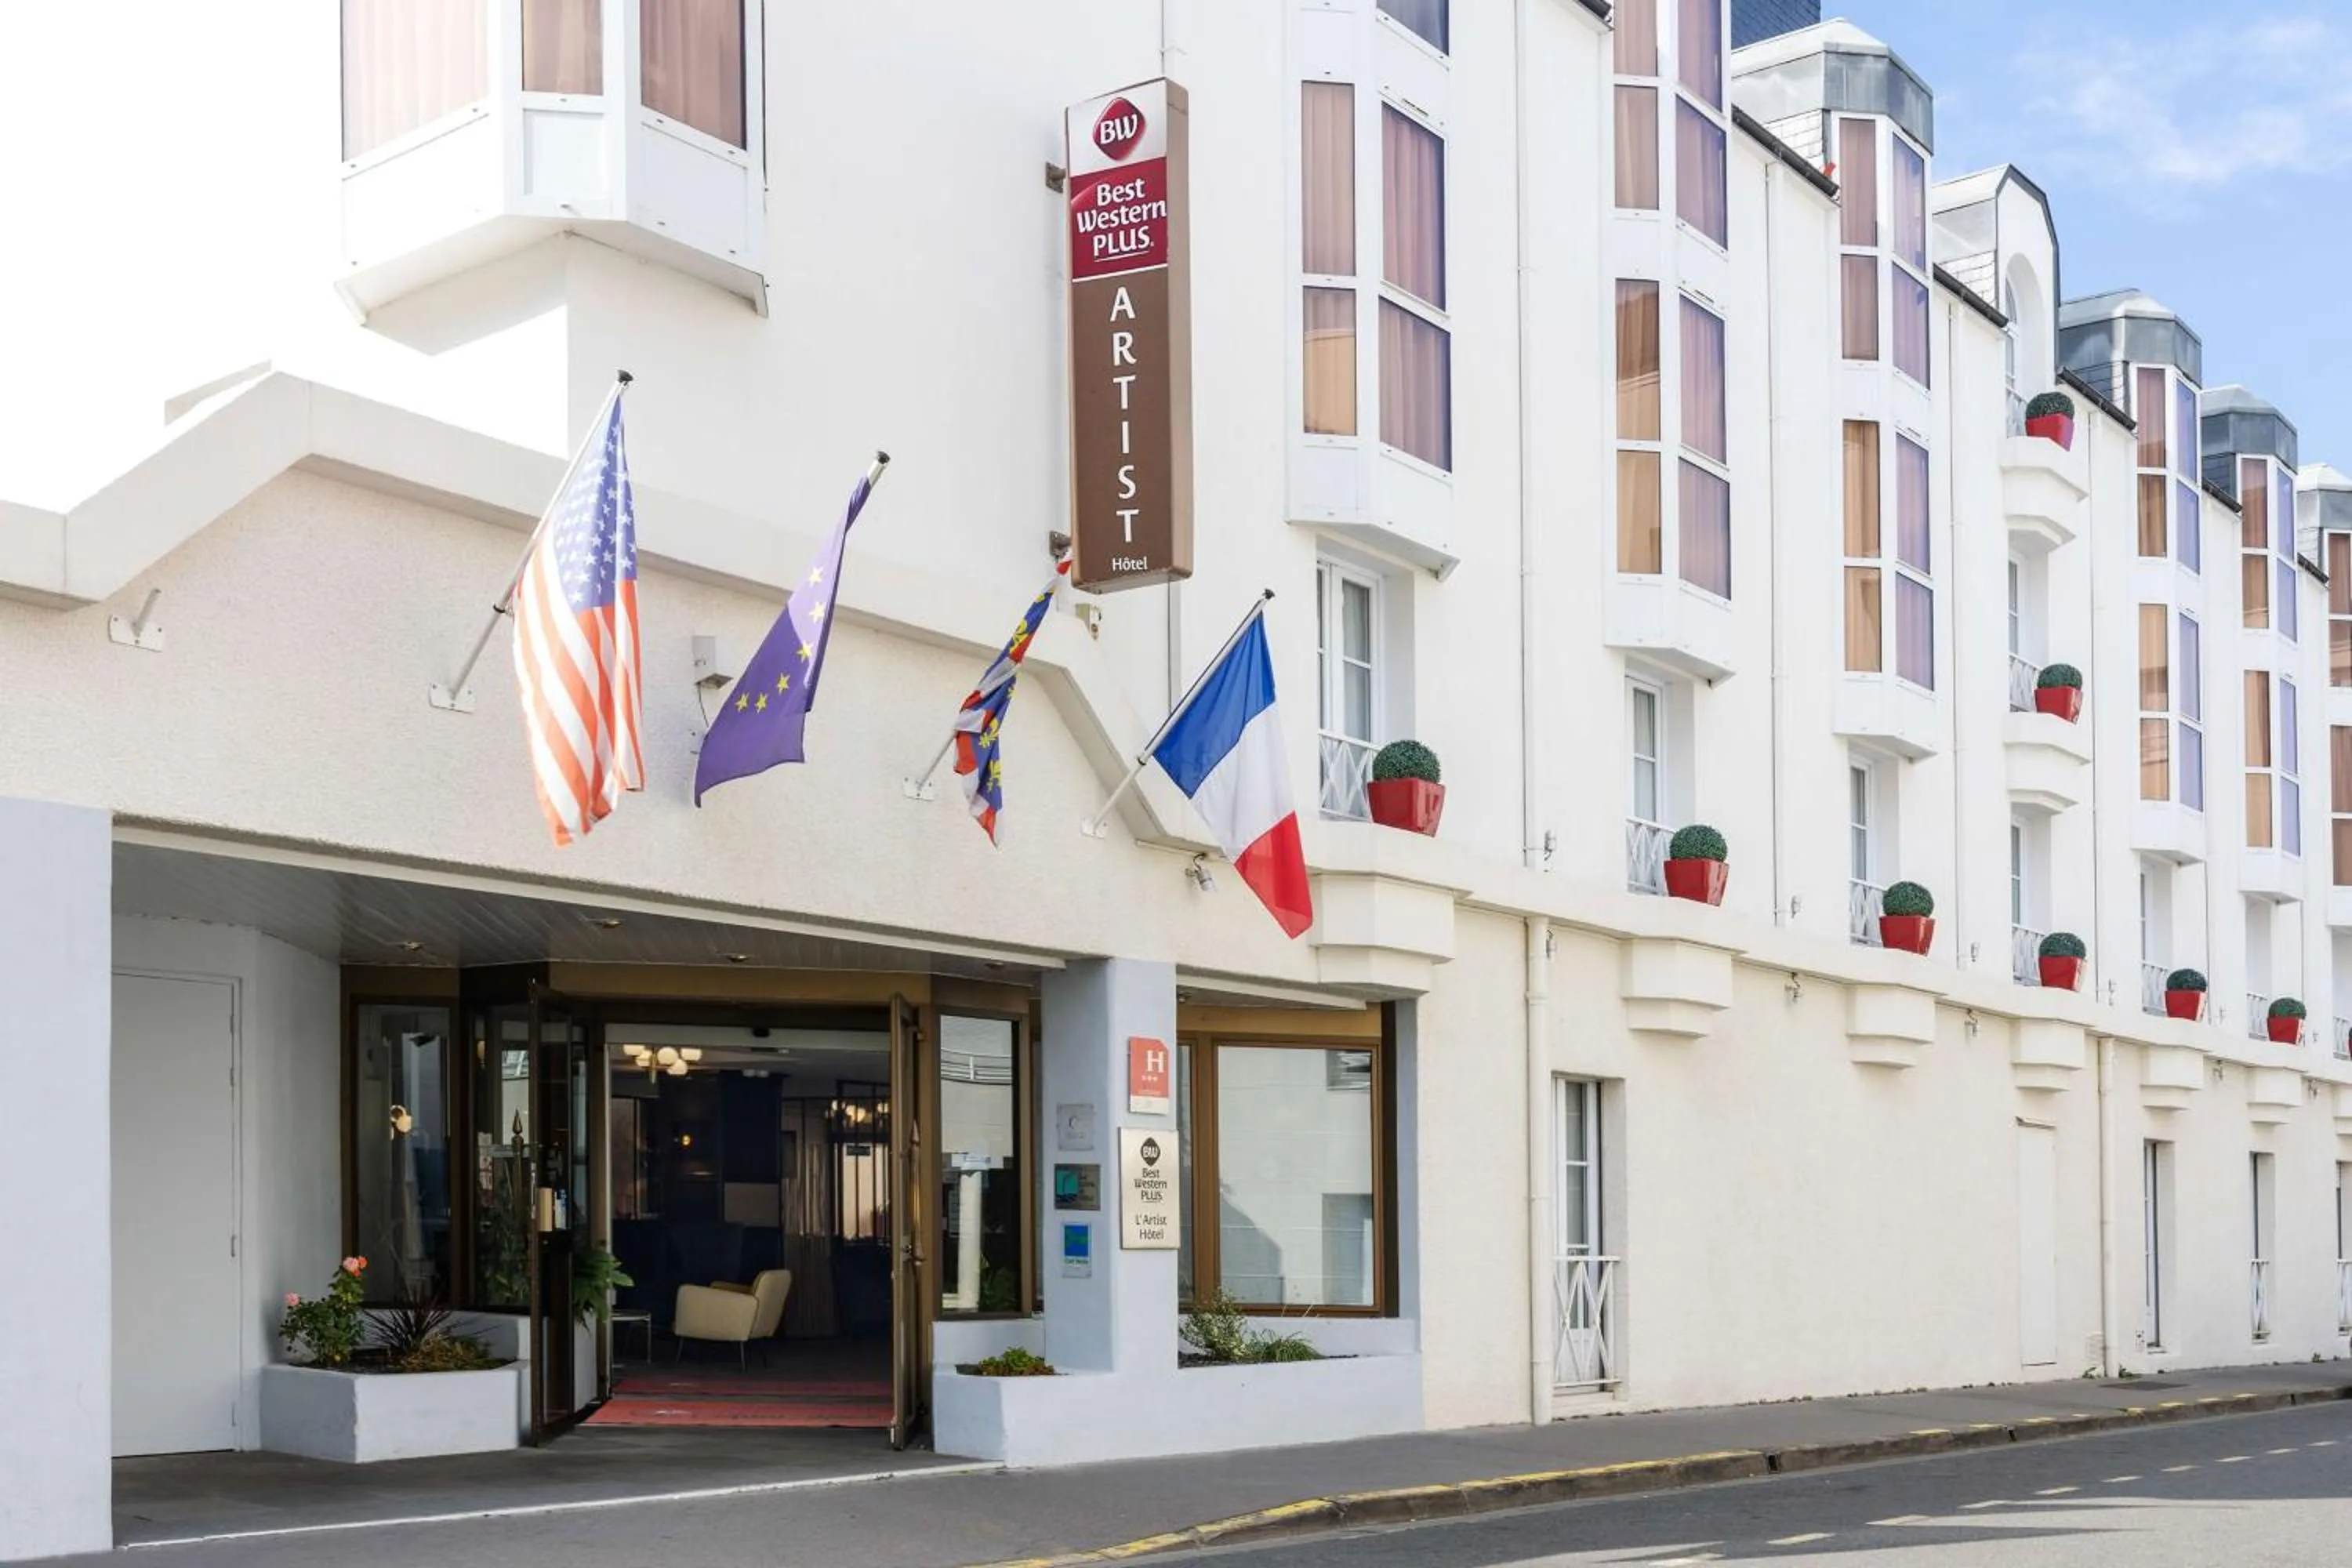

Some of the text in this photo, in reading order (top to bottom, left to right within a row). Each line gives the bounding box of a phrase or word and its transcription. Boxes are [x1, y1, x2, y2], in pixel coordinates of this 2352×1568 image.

[1101, 114, 1138, 144] BW
[1097, 178, 1145, 206] Best
[1076, 200, 1167, 234] Western
[1093, 226, 1151, 256] PLUS
[1109, 286, 1140, 543] ARTIST
[1111, 556, 1148, 572] Hôtel
[1146, 1050, 1164, 1073] H
[1134, 1178, 1167, 1189] Western
[1142, 1168, 1160, 1178] Best
[1139, 1228, 1164, 1240] Hôtel
